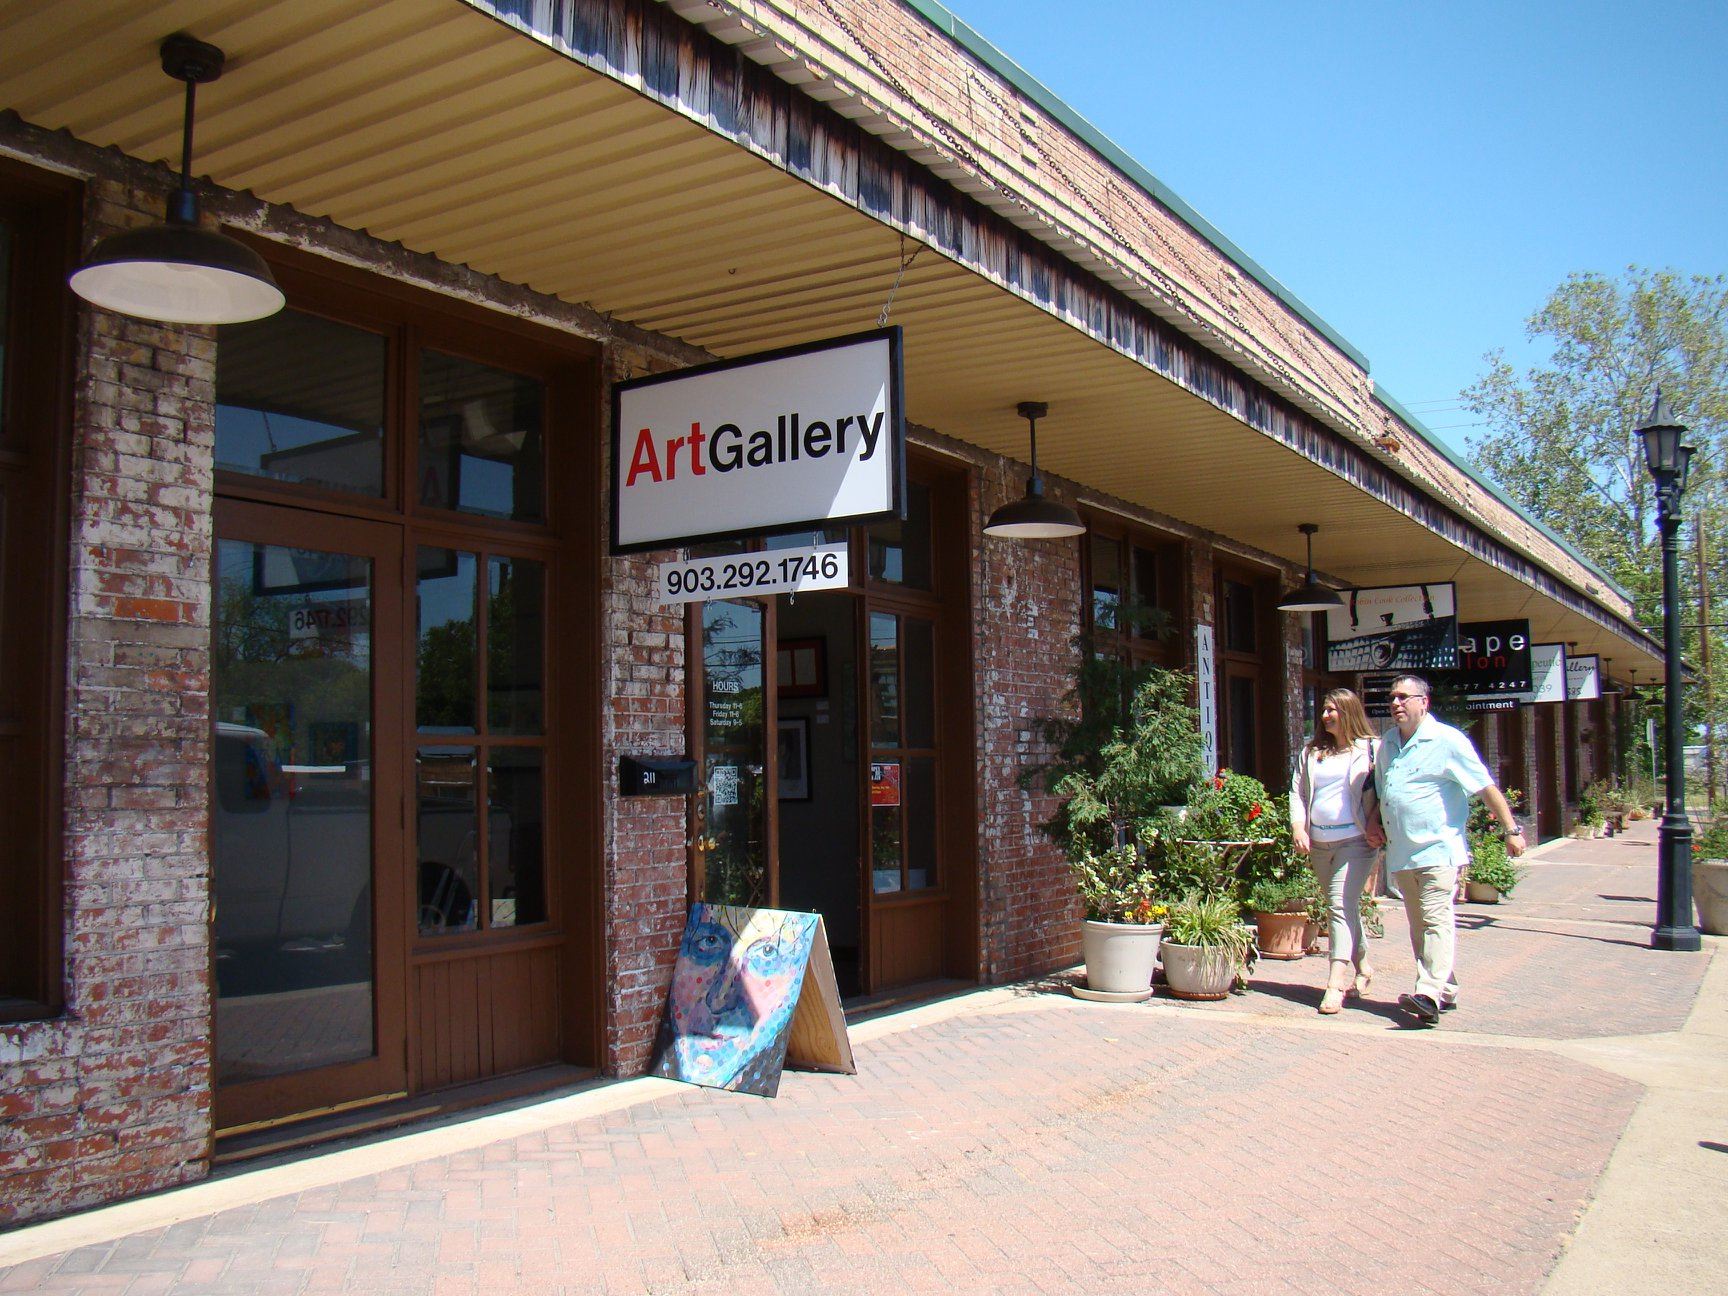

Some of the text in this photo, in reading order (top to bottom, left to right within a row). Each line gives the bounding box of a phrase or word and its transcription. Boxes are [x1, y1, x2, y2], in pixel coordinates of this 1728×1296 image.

[625, 411, 885, 487] ArtGallery
[667, 553, 839, 595] 903.292.1746
[712, 680, 740, 693] HOURS
[1489, 681, 1526, 689] 4247
[709, 702, 732, 710] Thursday
[712, 710, 728, 719] Friday
[709, 718, 732, 727] Saturday
